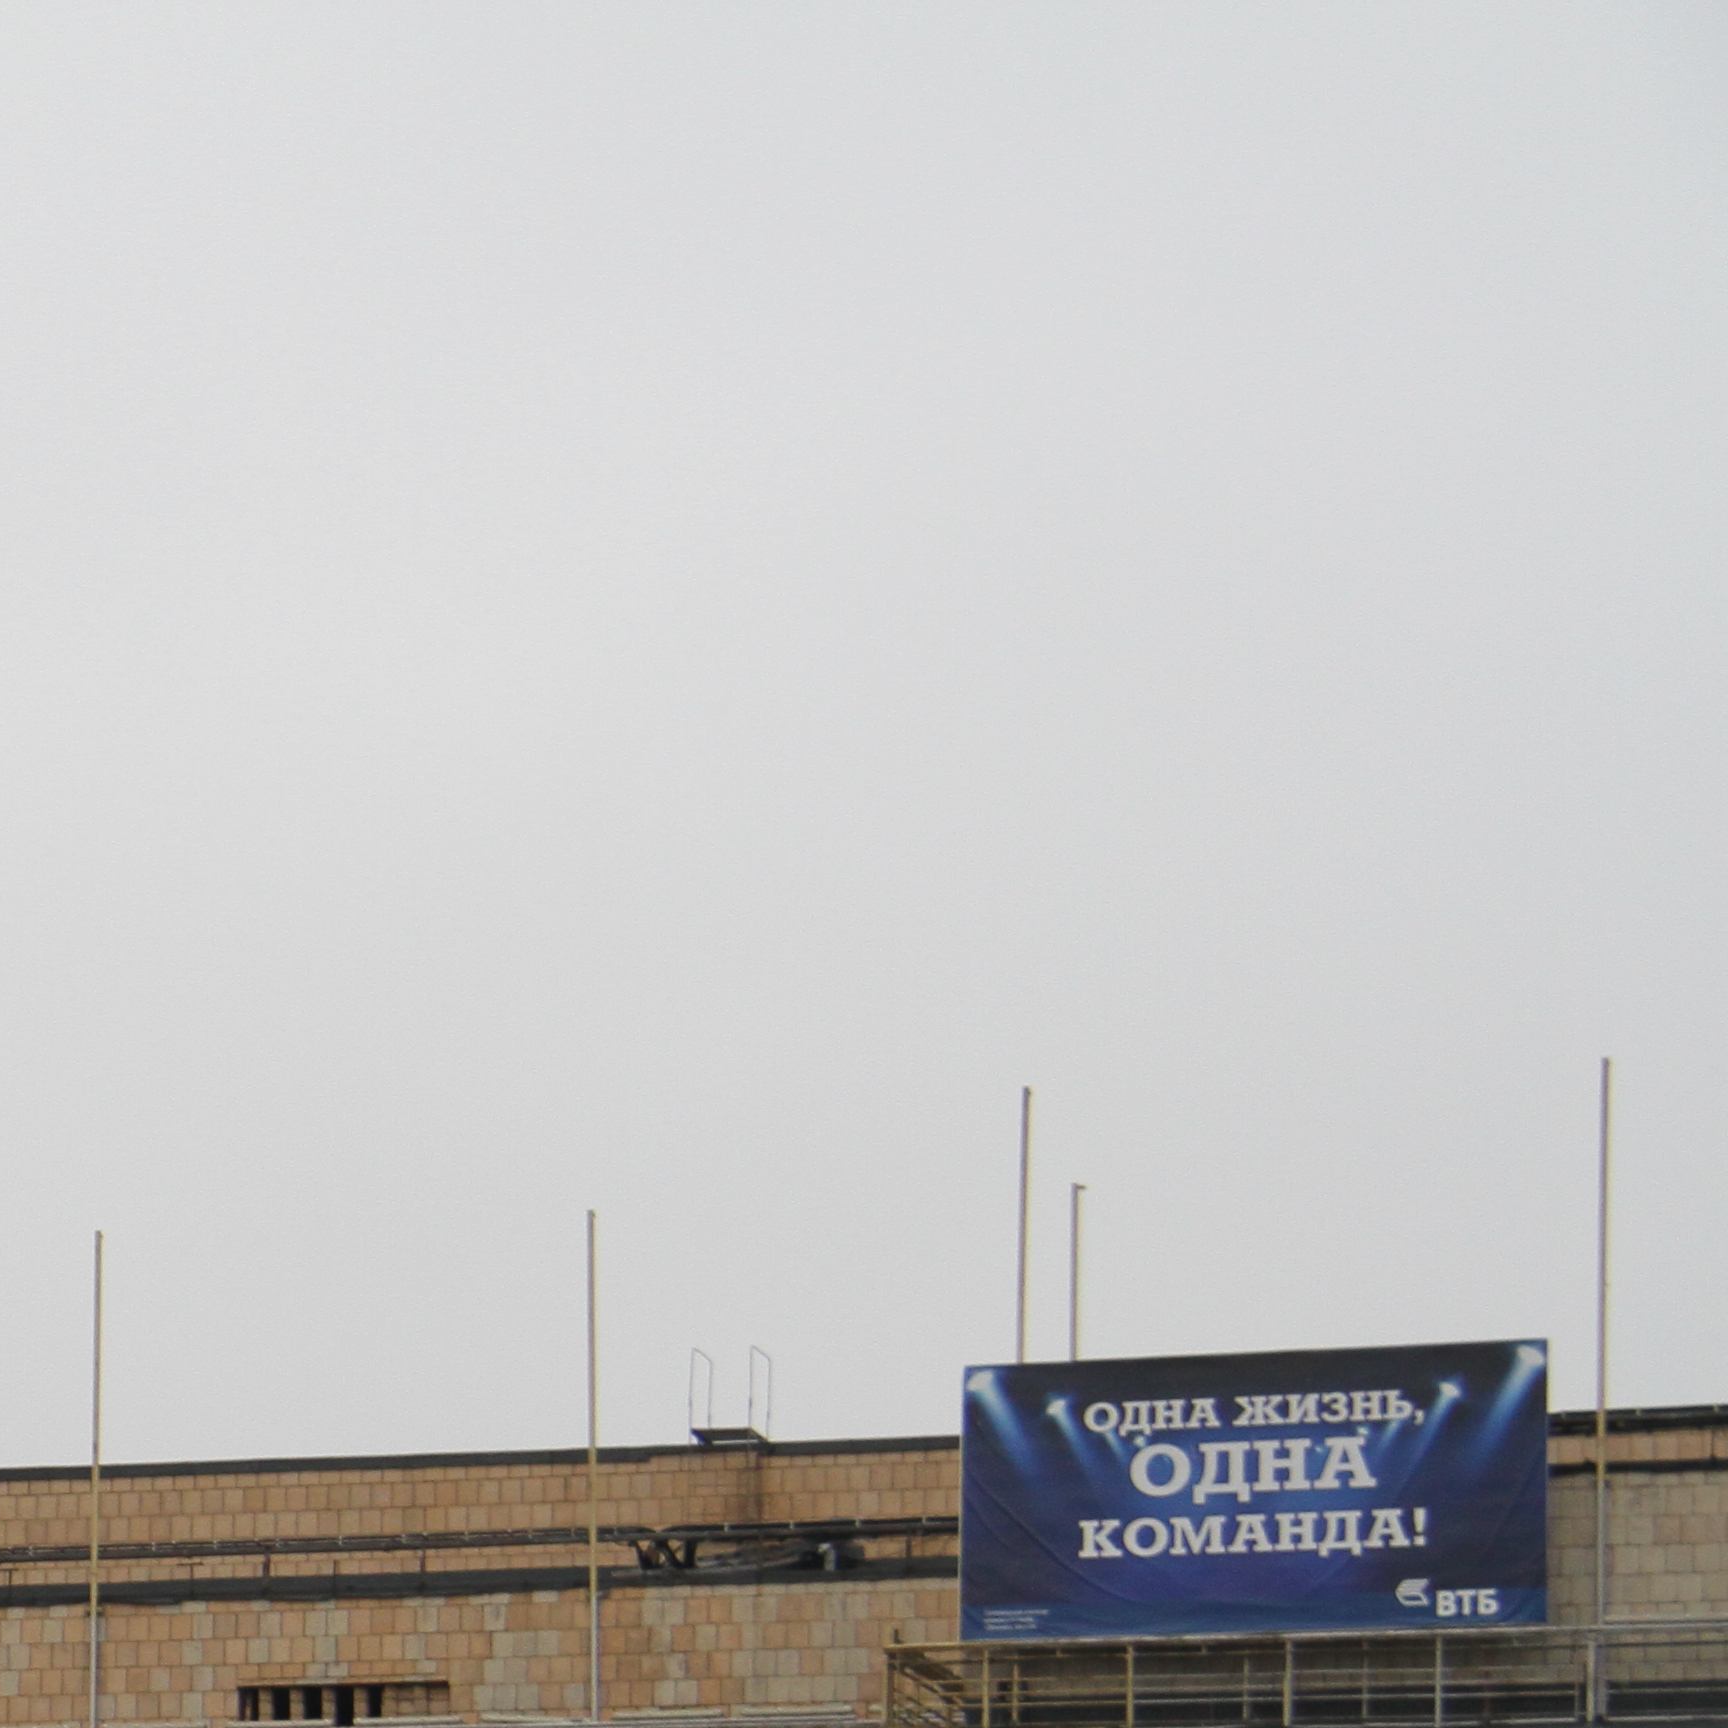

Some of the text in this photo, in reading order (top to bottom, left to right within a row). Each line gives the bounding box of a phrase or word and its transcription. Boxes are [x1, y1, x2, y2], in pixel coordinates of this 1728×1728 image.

[1082, 1389, 1425, 1434] ОДНА ЖИЗНЬ,
[1129, 1436, 1376, 1505] ОДНА
[1077, 1508, 1427, 1558] КОМАНДА!
[1435, 1588, 1499, 1618] ВТБ
